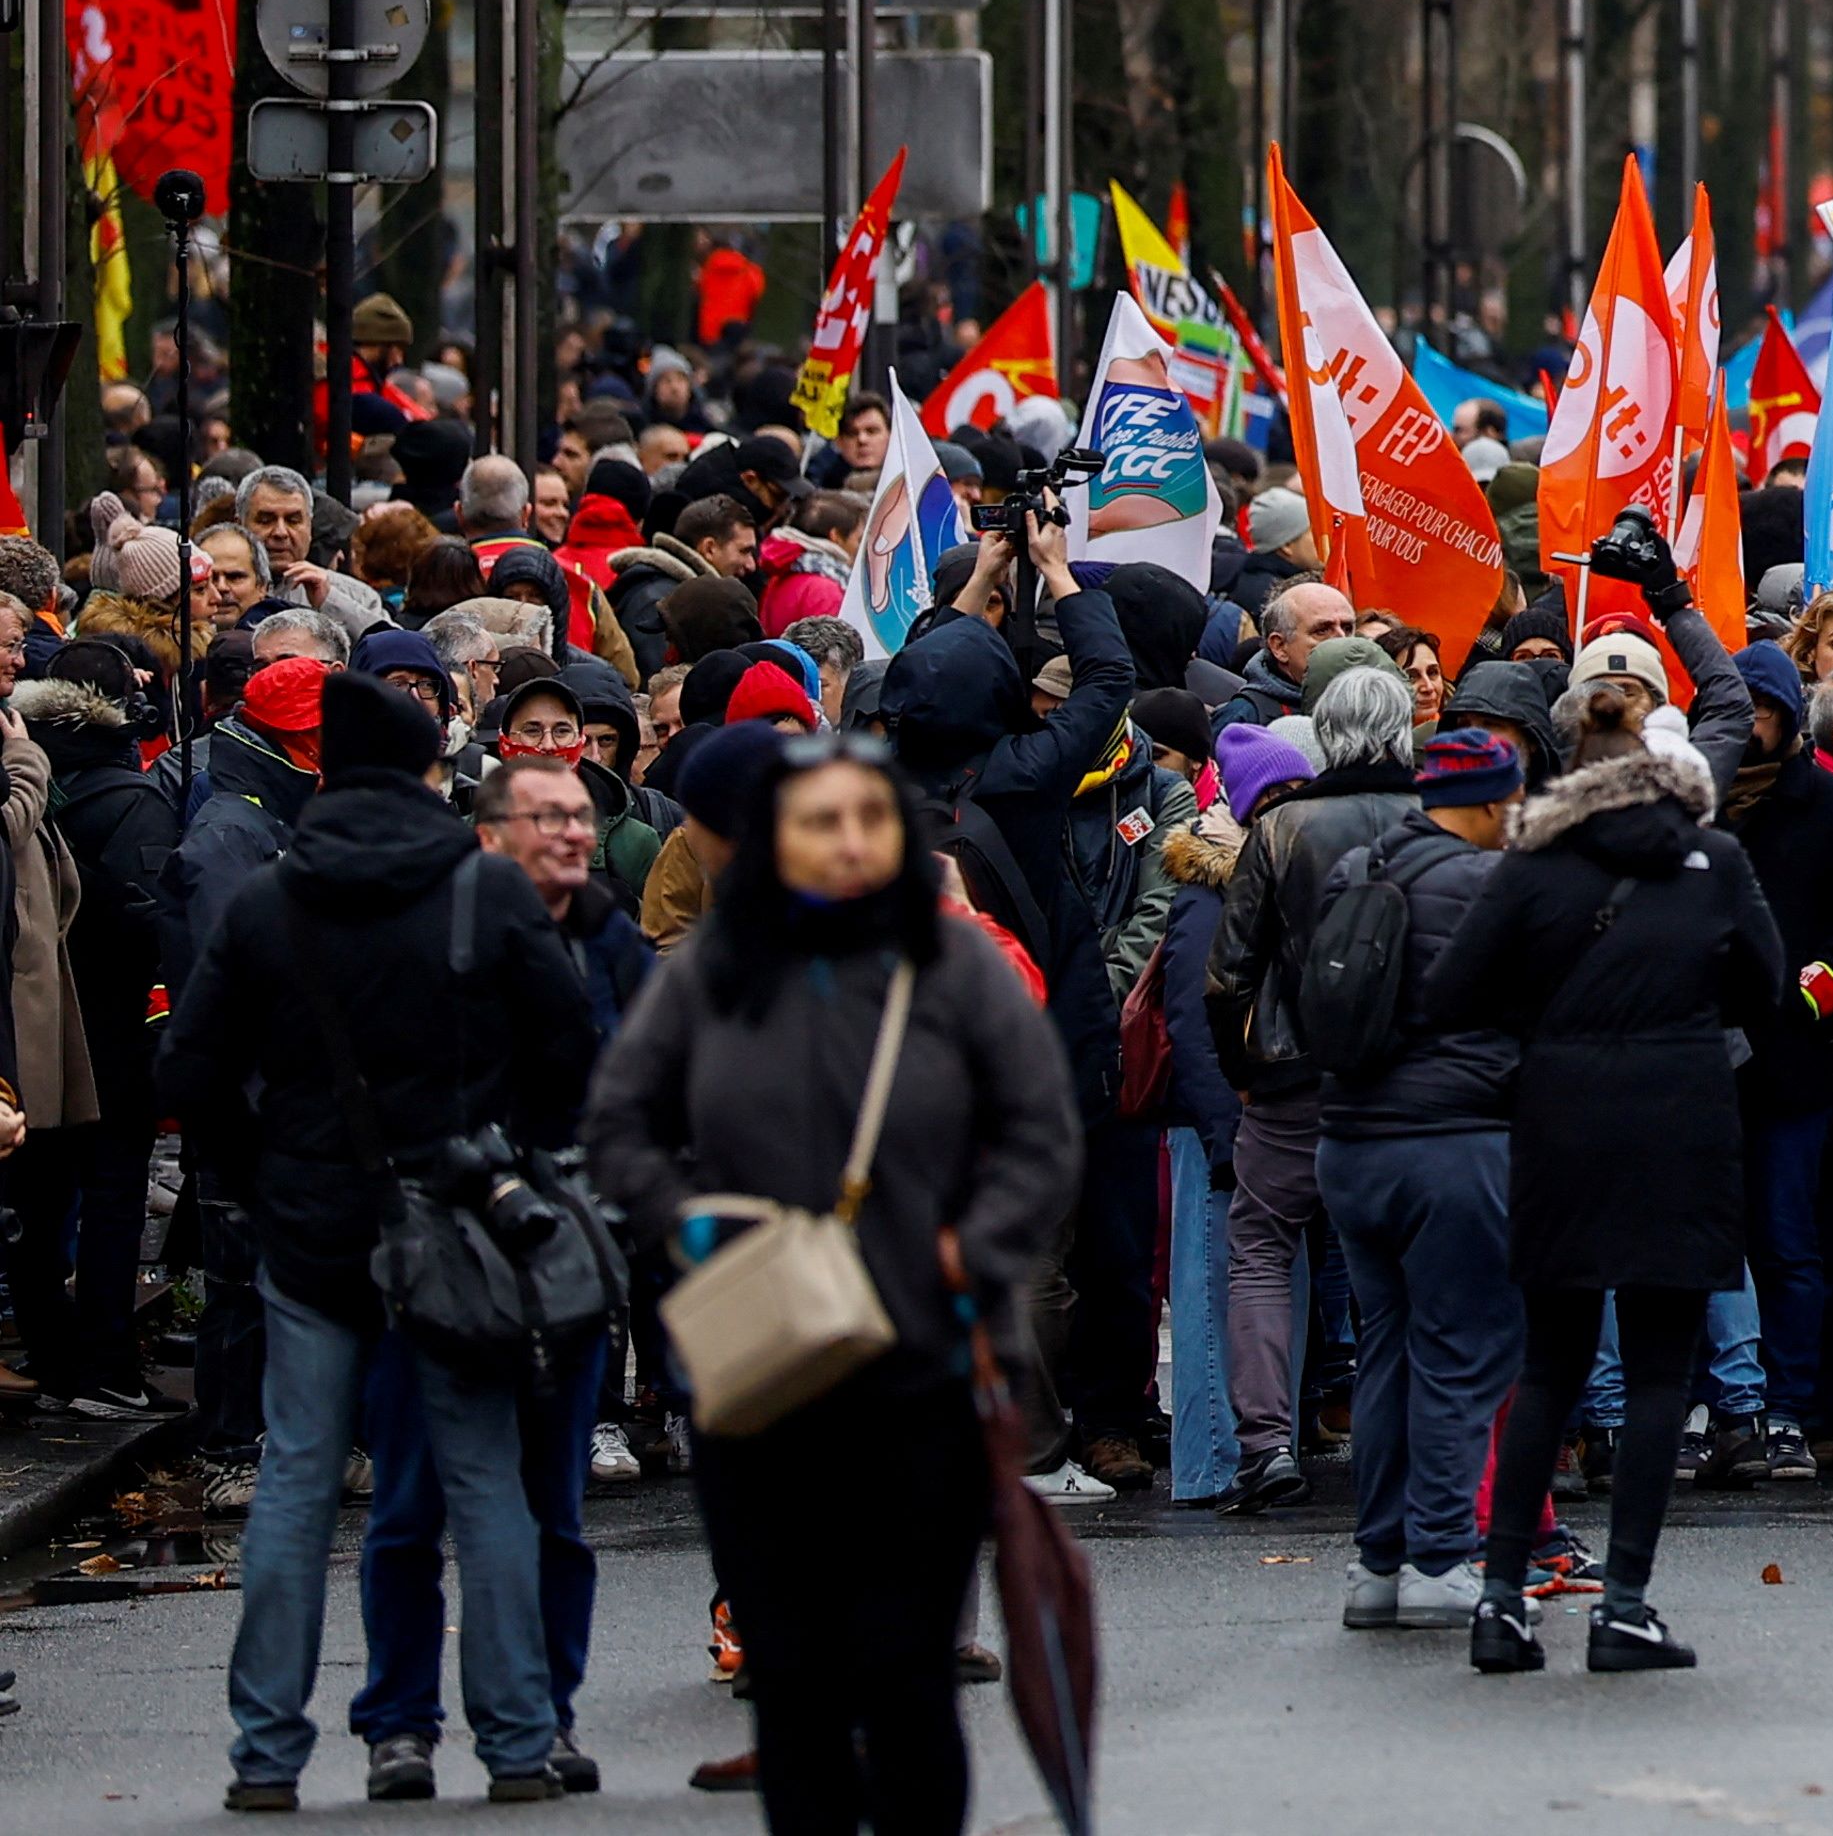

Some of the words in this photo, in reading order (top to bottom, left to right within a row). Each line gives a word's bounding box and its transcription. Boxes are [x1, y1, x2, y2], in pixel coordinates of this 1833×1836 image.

[1100, 393, 1182, 440] CFE
[1377, 406, 1444, 467] FEP
[1100, 444, 1197, 485] CGC
[1366, 514, 1401, 552] POUR
[1397, 528, 1429, 565] TOUS
[1407, 494, 1452, 540] POUR
[1443, 515, 1503, 570] CHACUN
